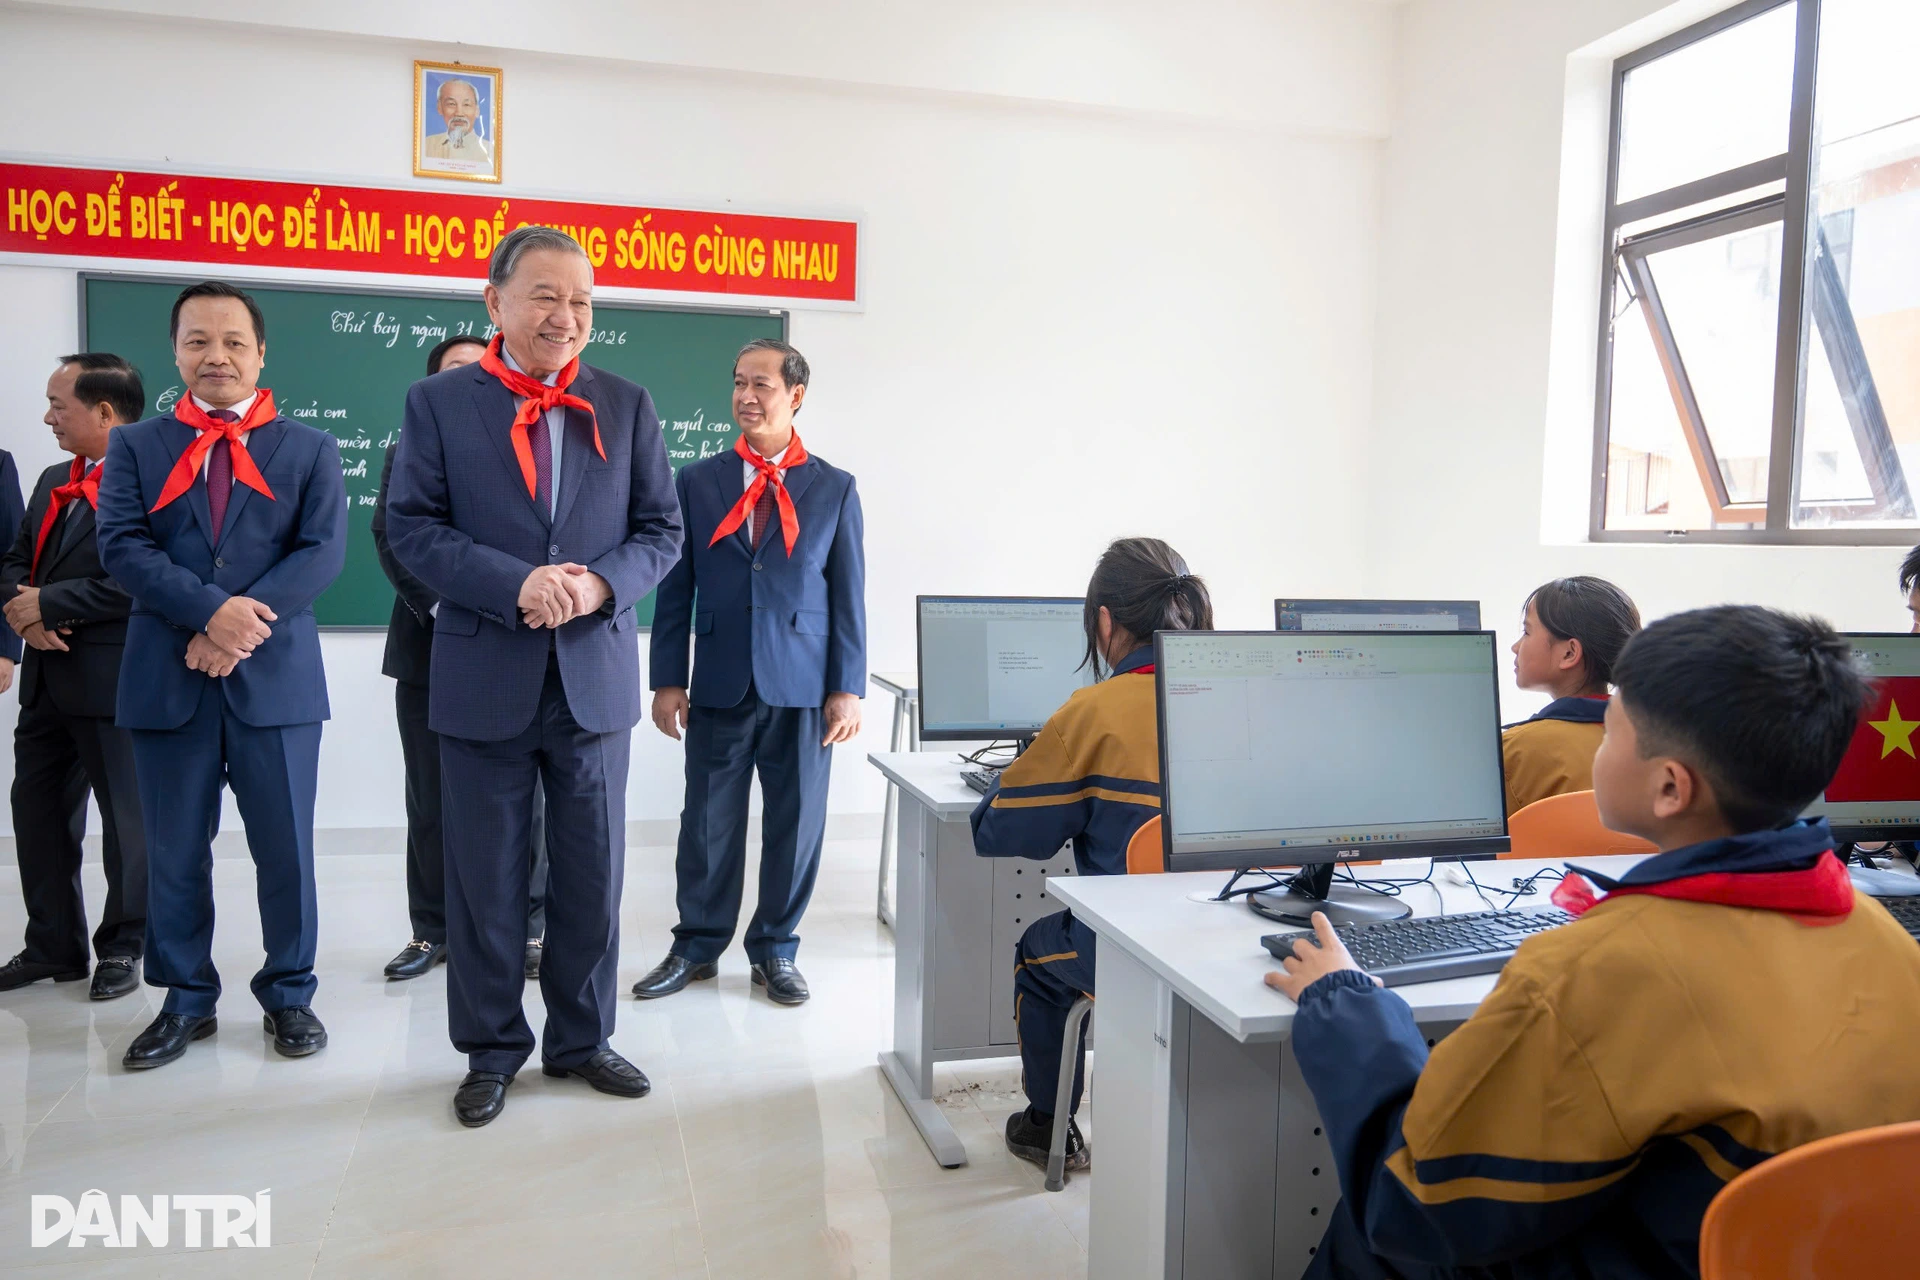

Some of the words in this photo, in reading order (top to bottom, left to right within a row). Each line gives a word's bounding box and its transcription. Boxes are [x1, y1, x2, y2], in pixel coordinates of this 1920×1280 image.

[8, 188, 76, 240] HỌC
[85, 173, 124, 237] ĐỂ
[131, 181, 185, 240] BIẾT
[210, 201, 274, 252] HỌC
[283, 188, 321, 248] ĐỂ
[326, 198, 380, 253] LÀM
[405, 214, 465, 263] HỌC
[473, 200, 509, 259] ĐỂ
[614, 214, 687, 272] SỐNG
[693, 225, 766, 277] CÙNG
[773, 239, 838, 282] NHAU
[373, 312, 401, 348] bảy
[410, 315, 447, 348] ngày
[456, 320, 473, 336] 31
[587, 327, 627, 345] 2026
[324, 409, 348, 418] em
[707, 423, 731, 432] cao
[1336, 849, 1360, 858] ASUS
